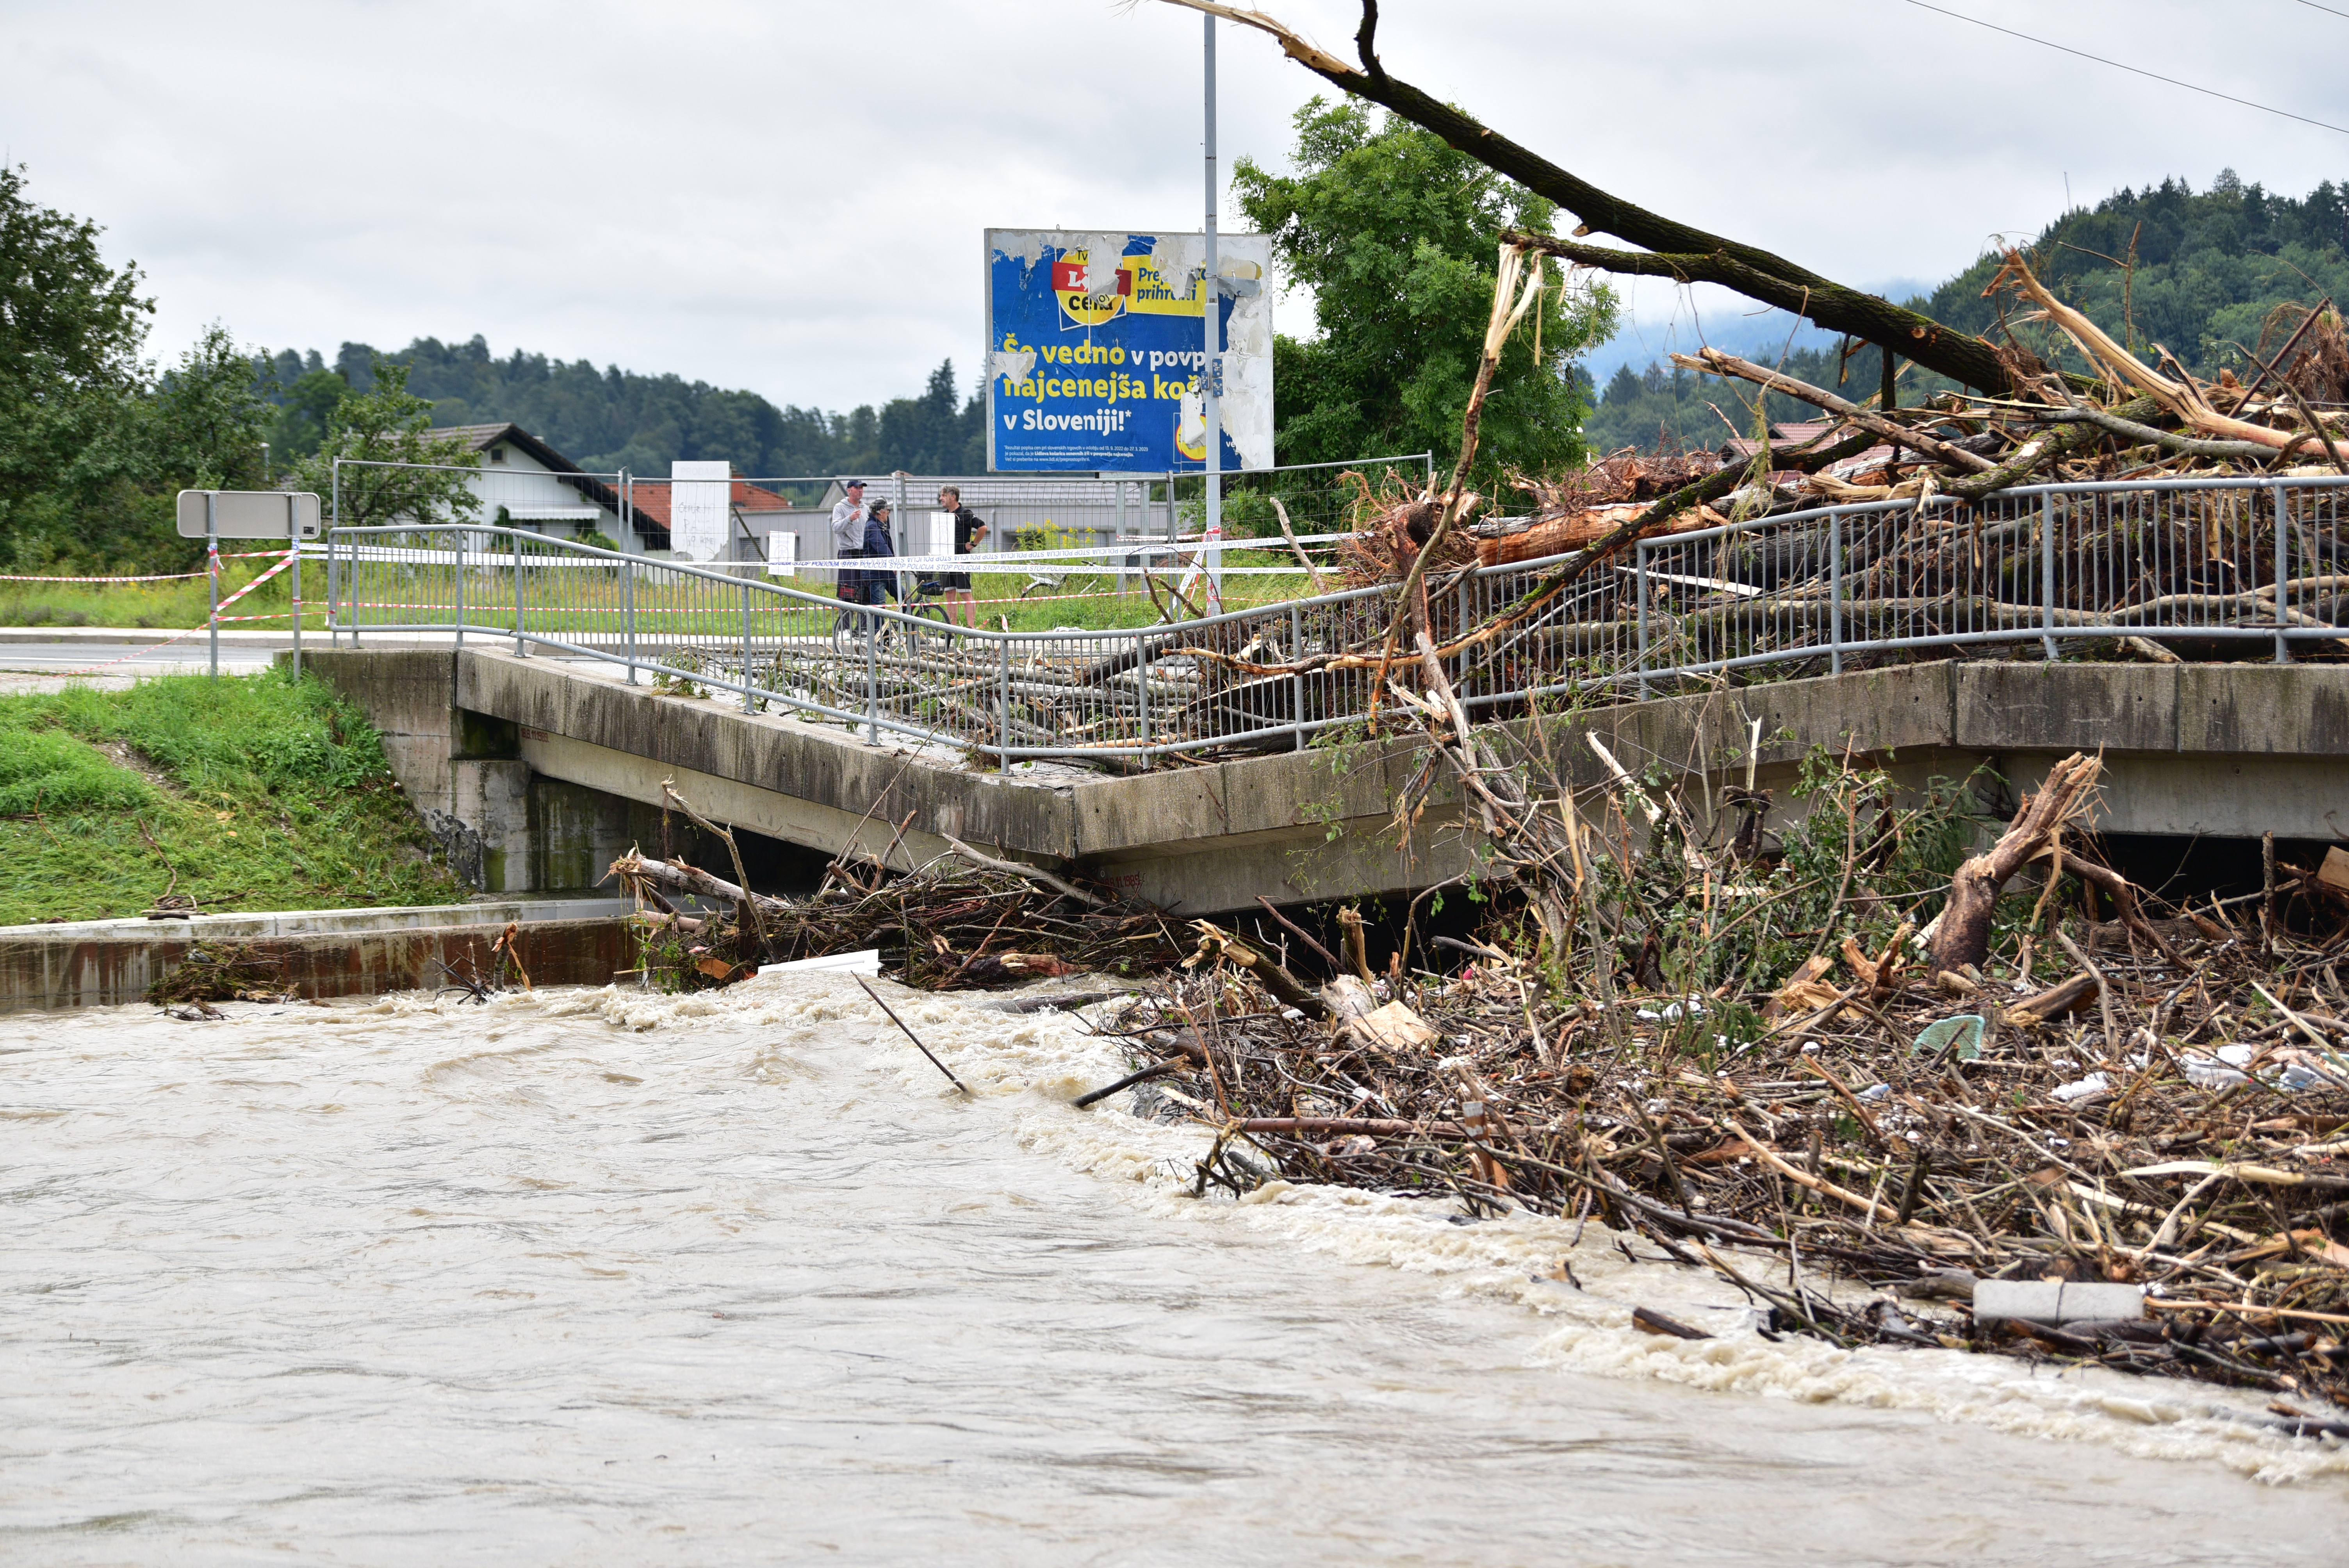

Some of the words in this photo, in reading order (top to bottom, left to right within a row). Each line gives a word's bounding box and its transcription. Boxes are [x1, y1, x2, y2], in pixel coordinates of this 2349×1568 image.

[1137, 283, 1197, 303] prihri
[1041, 339, 1125, 364] vedno
[1131, 351, 1144, 365] v
[1150, 351, 1205, 371] povp
[1003, 370, 1146, 404] najcenejša
[1003, 415, 1017, 430] v
[680, 467, 723, 476] PRODAMO
